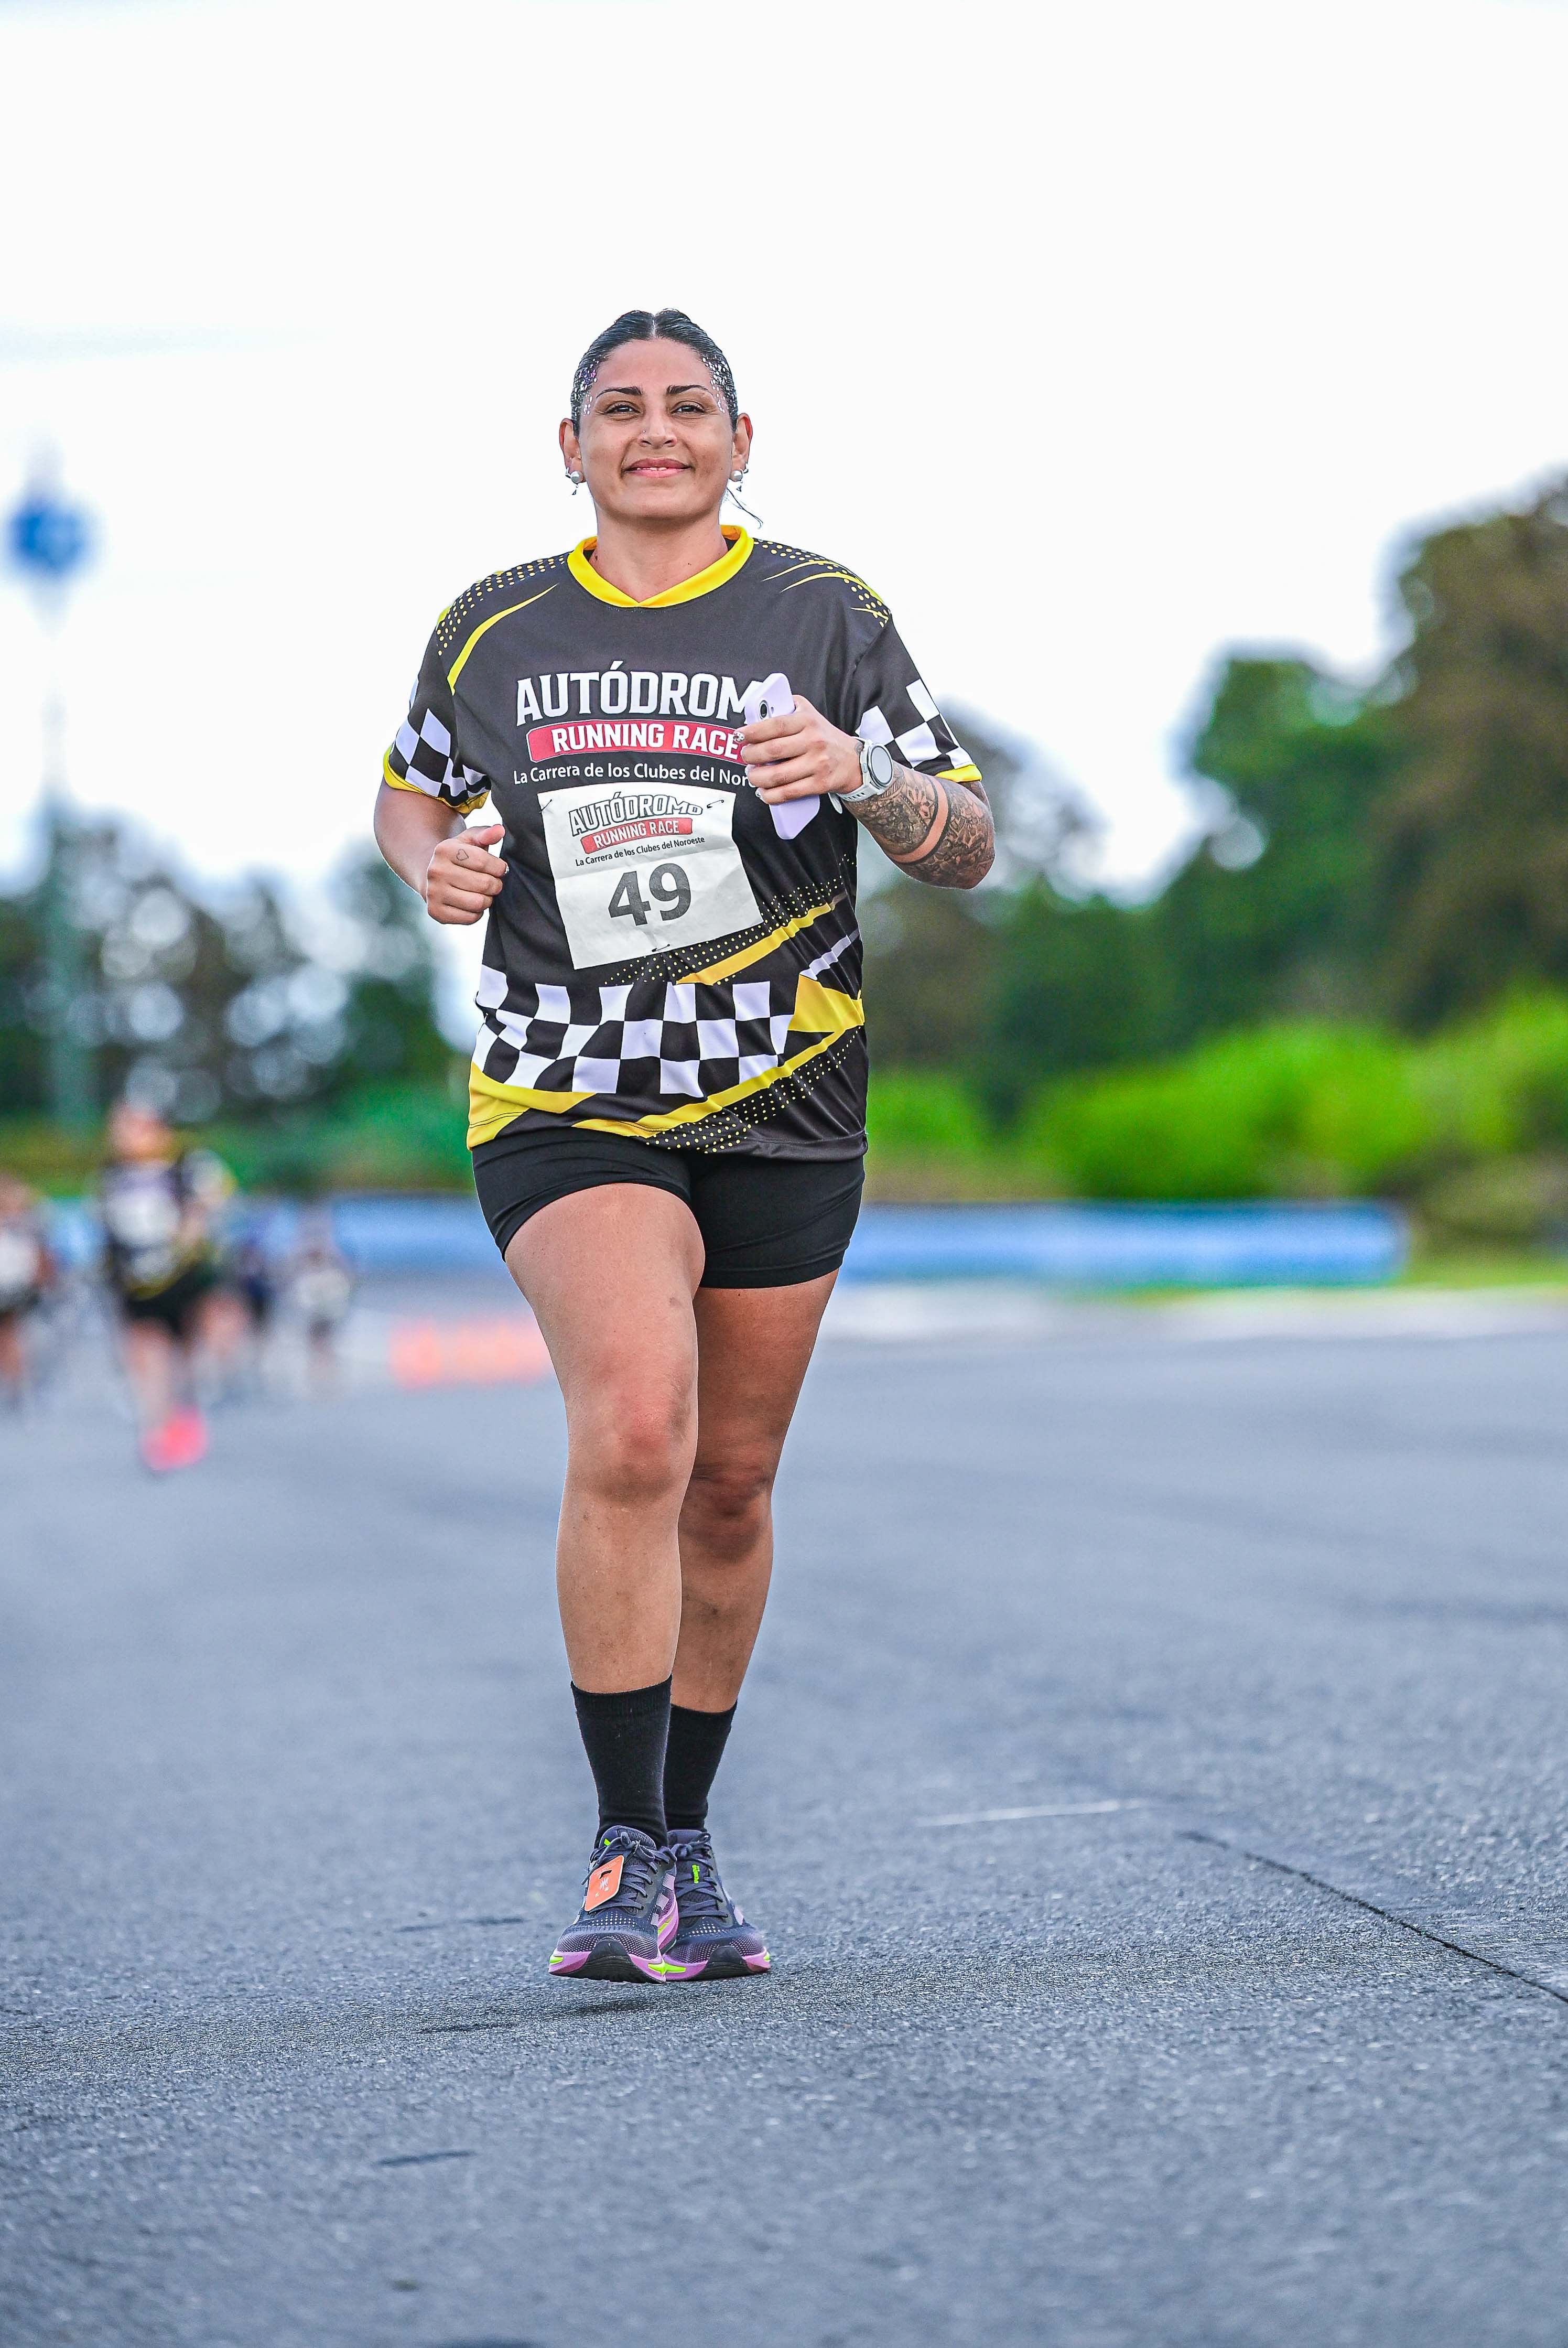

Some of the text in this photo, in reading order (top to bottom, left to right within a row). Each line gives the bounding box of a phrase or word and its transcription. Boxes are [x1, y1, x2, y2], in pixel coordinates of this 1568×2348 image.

[516, 660, 763, 726] AUTÓDROM
[551, 723, 738, 760] RUNNING RACE
[514, 762, 748, 787] La Carrera de los Clubes del Nor
[569, 791, 703, 837] AUTÓDROMO
[585, 853, 613, 865] Carrera
[614, 849, 624, 858] de
[636, 845, 661, 854] Clubes
[662, 841, 673, 849] del
[674, 837, 705, 848] Noroeste
[593, 820, 679, 849] RUNNING RACE
[608, 863, 691, 927] 49
